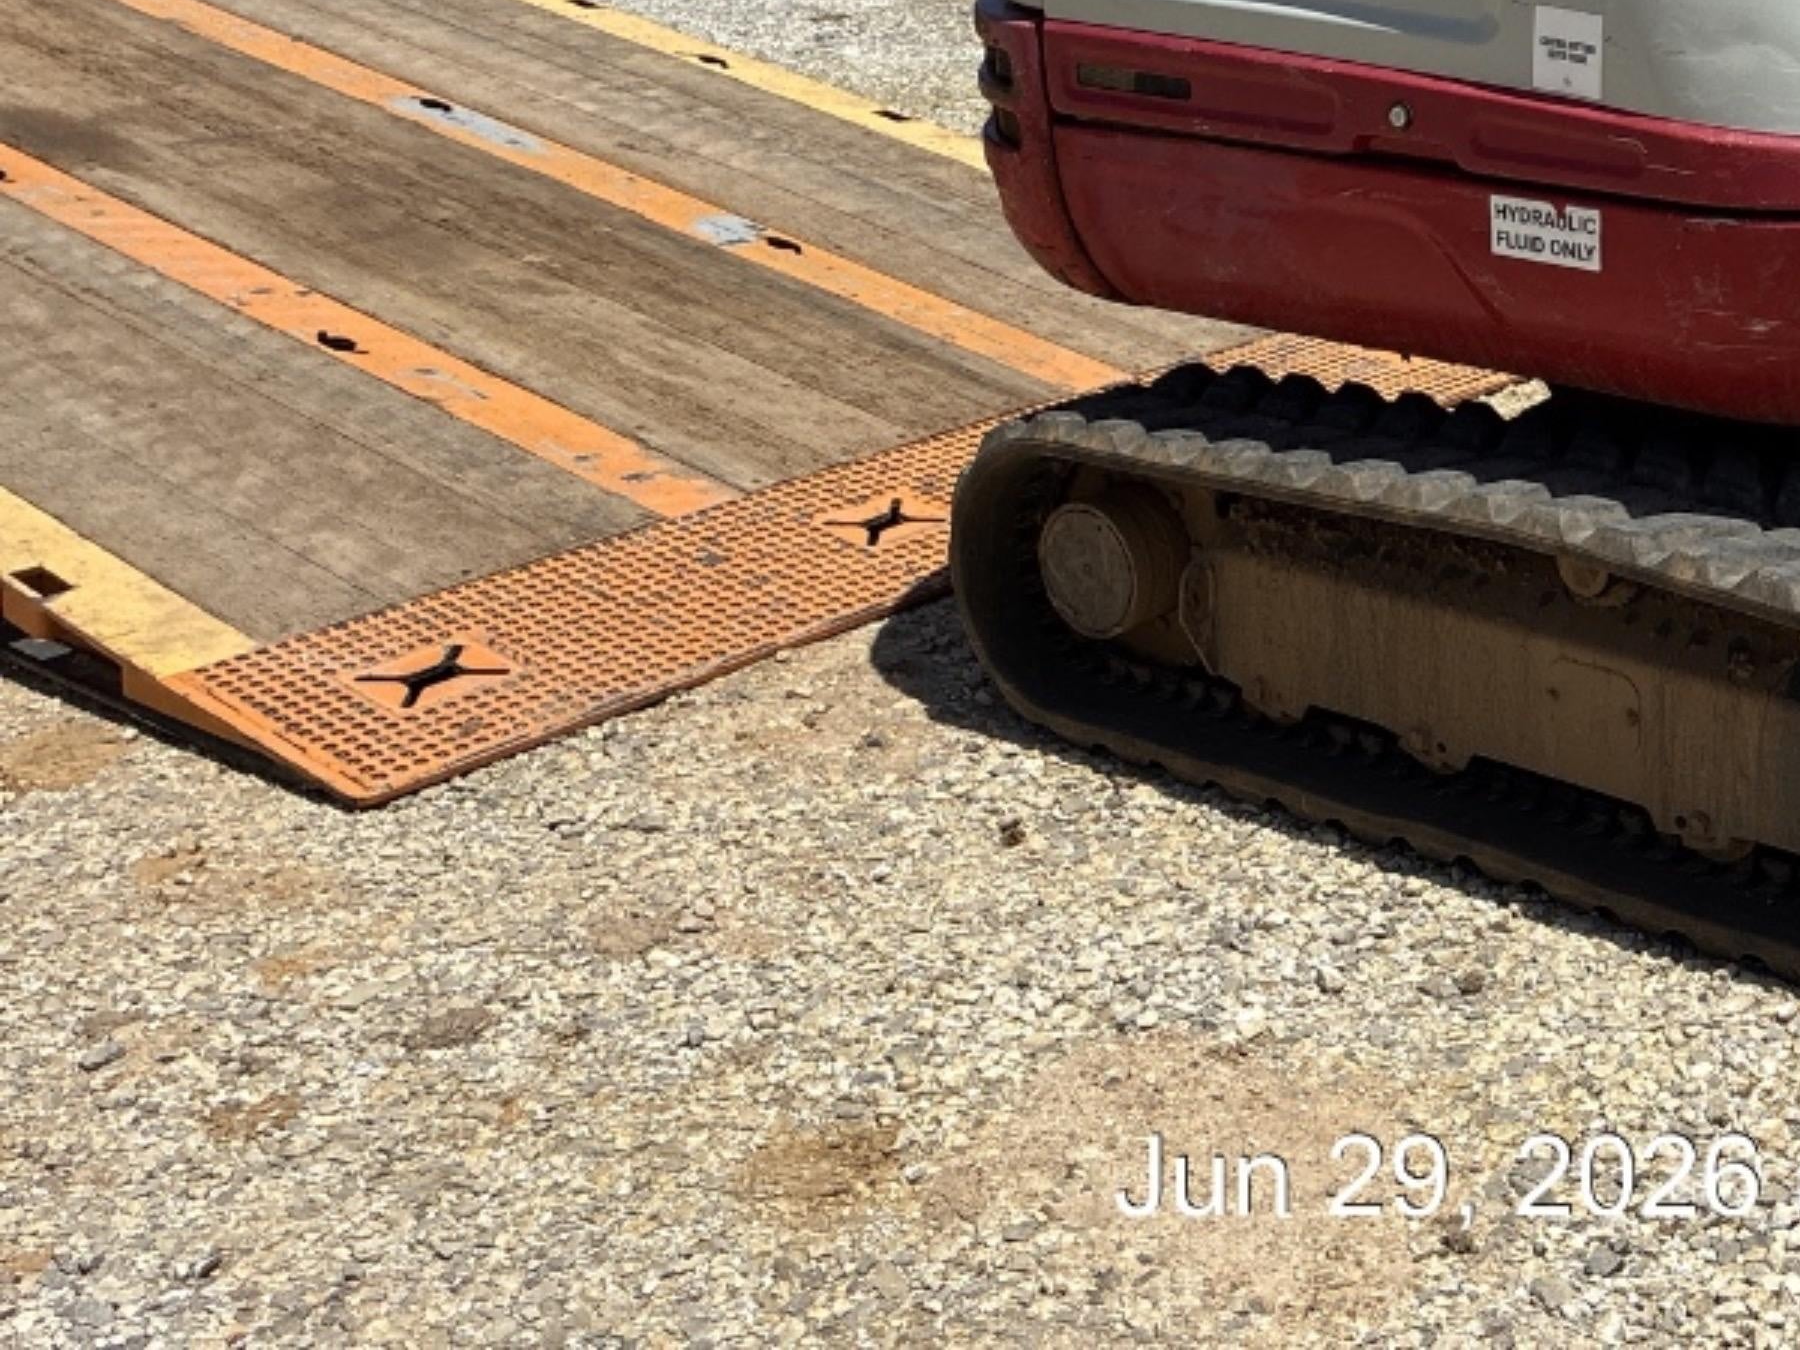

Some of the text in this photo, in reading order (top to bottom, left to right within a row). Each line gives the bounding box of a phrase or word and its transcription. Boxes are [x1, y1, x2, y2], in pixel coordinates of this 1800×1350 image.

[1495, 203, 1596, 235] HYDRAULIC
[1496, 230, 1596, 261] FLUID ONLY
